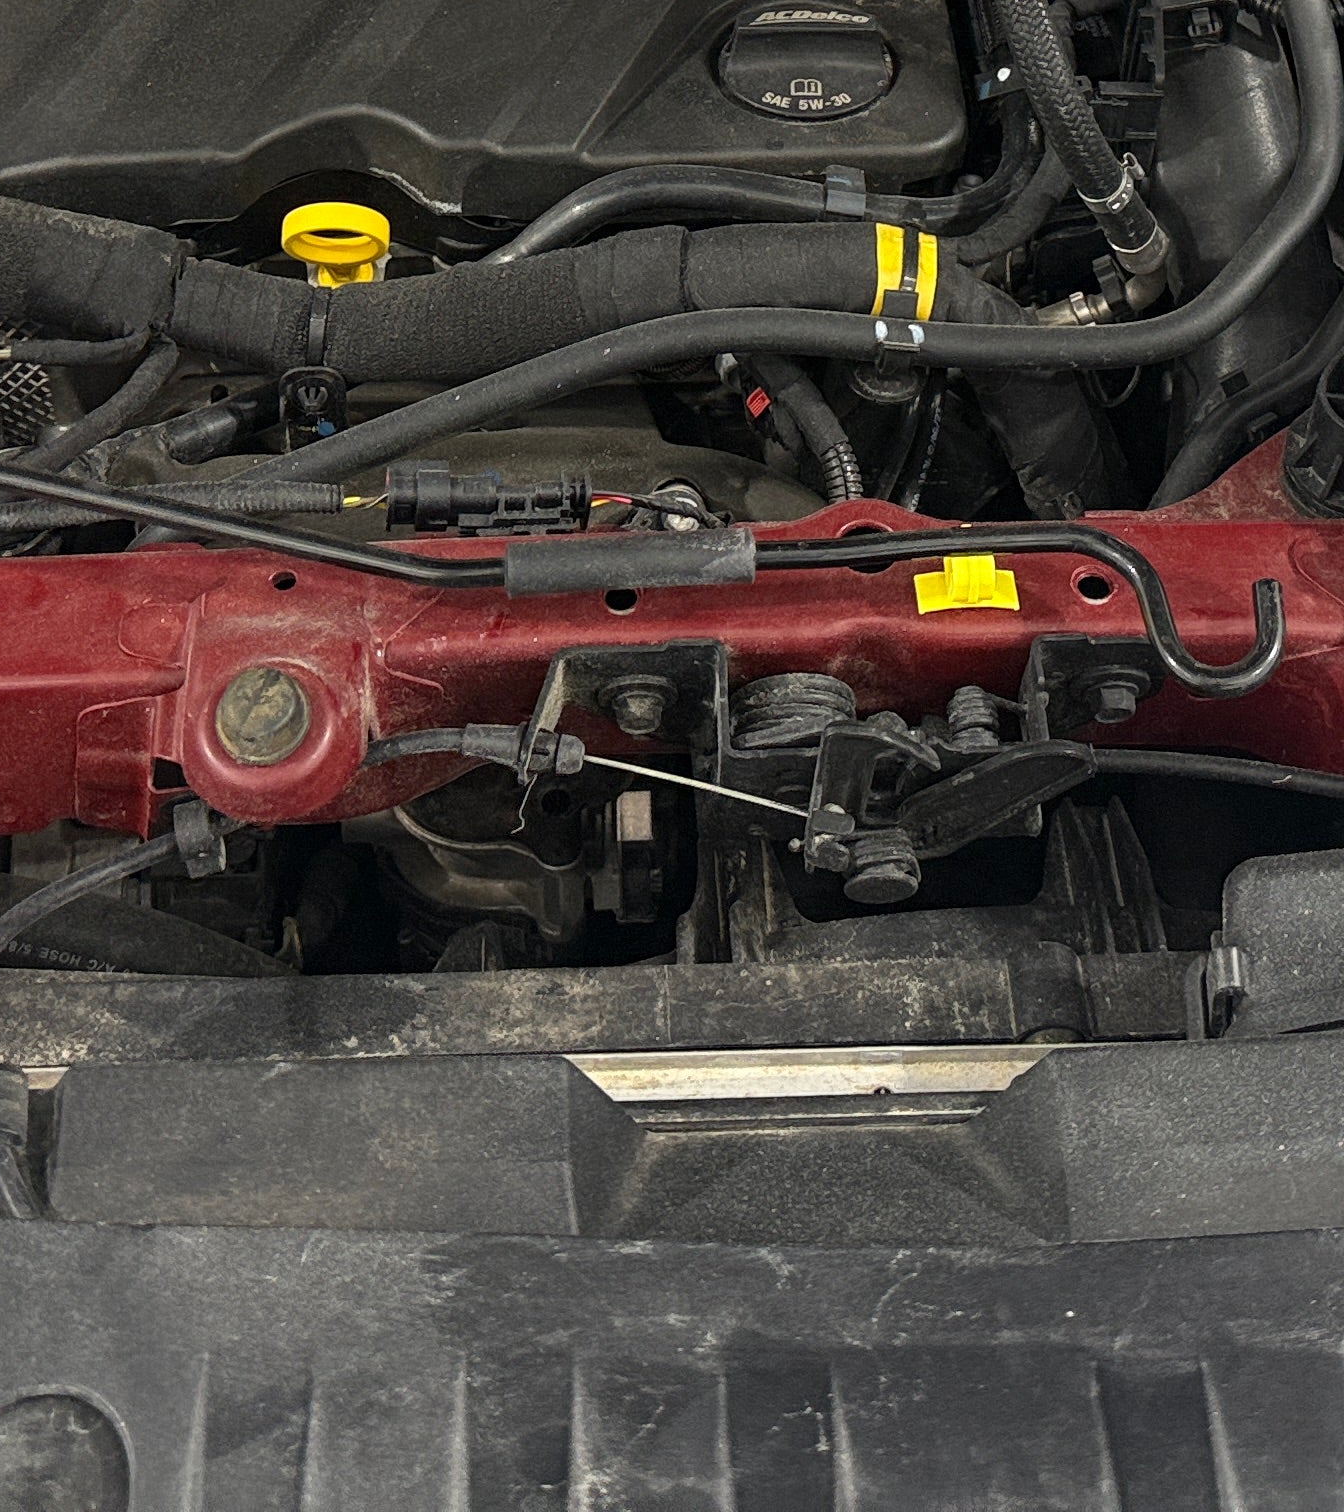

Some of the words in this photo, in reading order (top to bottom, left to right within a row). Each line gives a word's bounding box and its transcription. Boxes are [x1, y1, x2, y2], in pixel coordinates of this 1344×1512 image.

[752, 10, 870, 24] ACDelco
[761, 91, 792, 108] SAE
[798, 92, 852, 111] 5W-30
